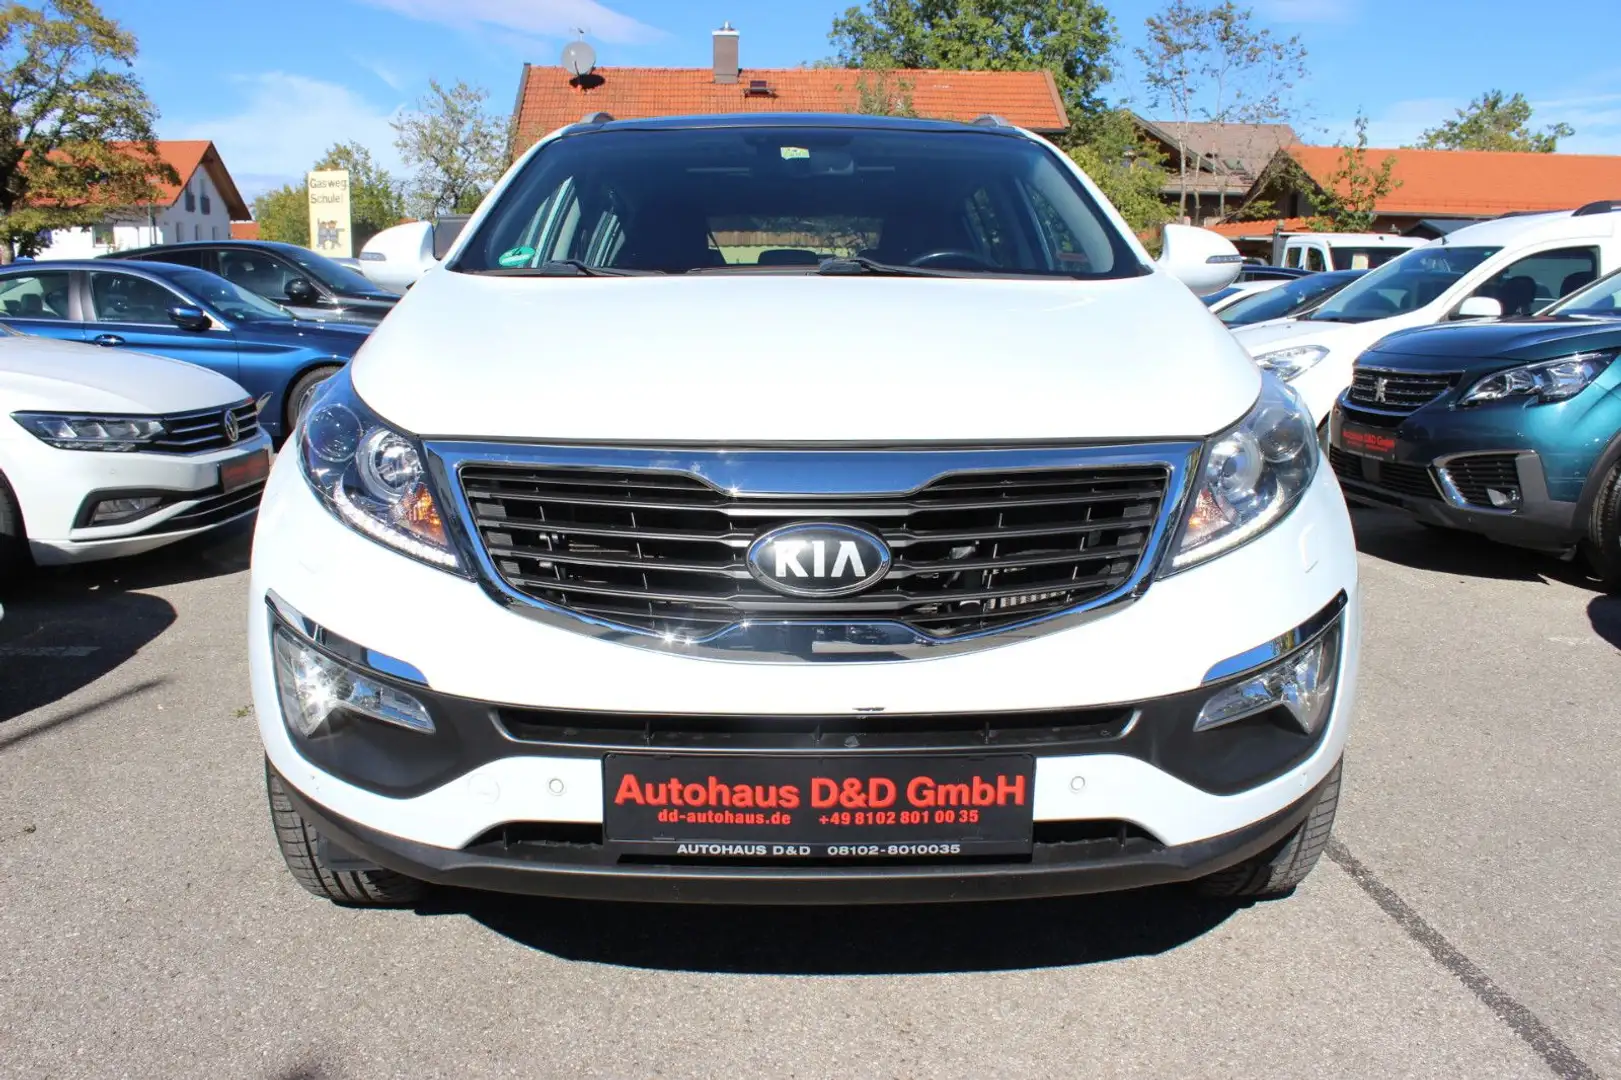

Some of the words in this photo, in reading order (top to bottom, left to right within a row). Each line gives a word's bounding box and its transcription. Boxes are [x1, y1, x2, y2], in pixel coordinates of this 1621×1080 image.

[773, 540, 867, 578] KIA
[614, 773, 801, 809] Autohaus
[810, 777, 897, 809] D&D
[906, 775, 1025, 808] GmbH
[657, 808, 792, 825] dd-autohaus.de
[818, 811, 851, 825] +49
[854, 811, 896, 825] 8102
[899, 810, 930, 825] 801
[934, 809, 955, 824] 00
[958, 809, 979, 823] 35
[676, 843, 767, 856] AUTOHAUS
[772, 844, 811, 856] D&D
[827, 843, 961, 856] 08102-8010035
